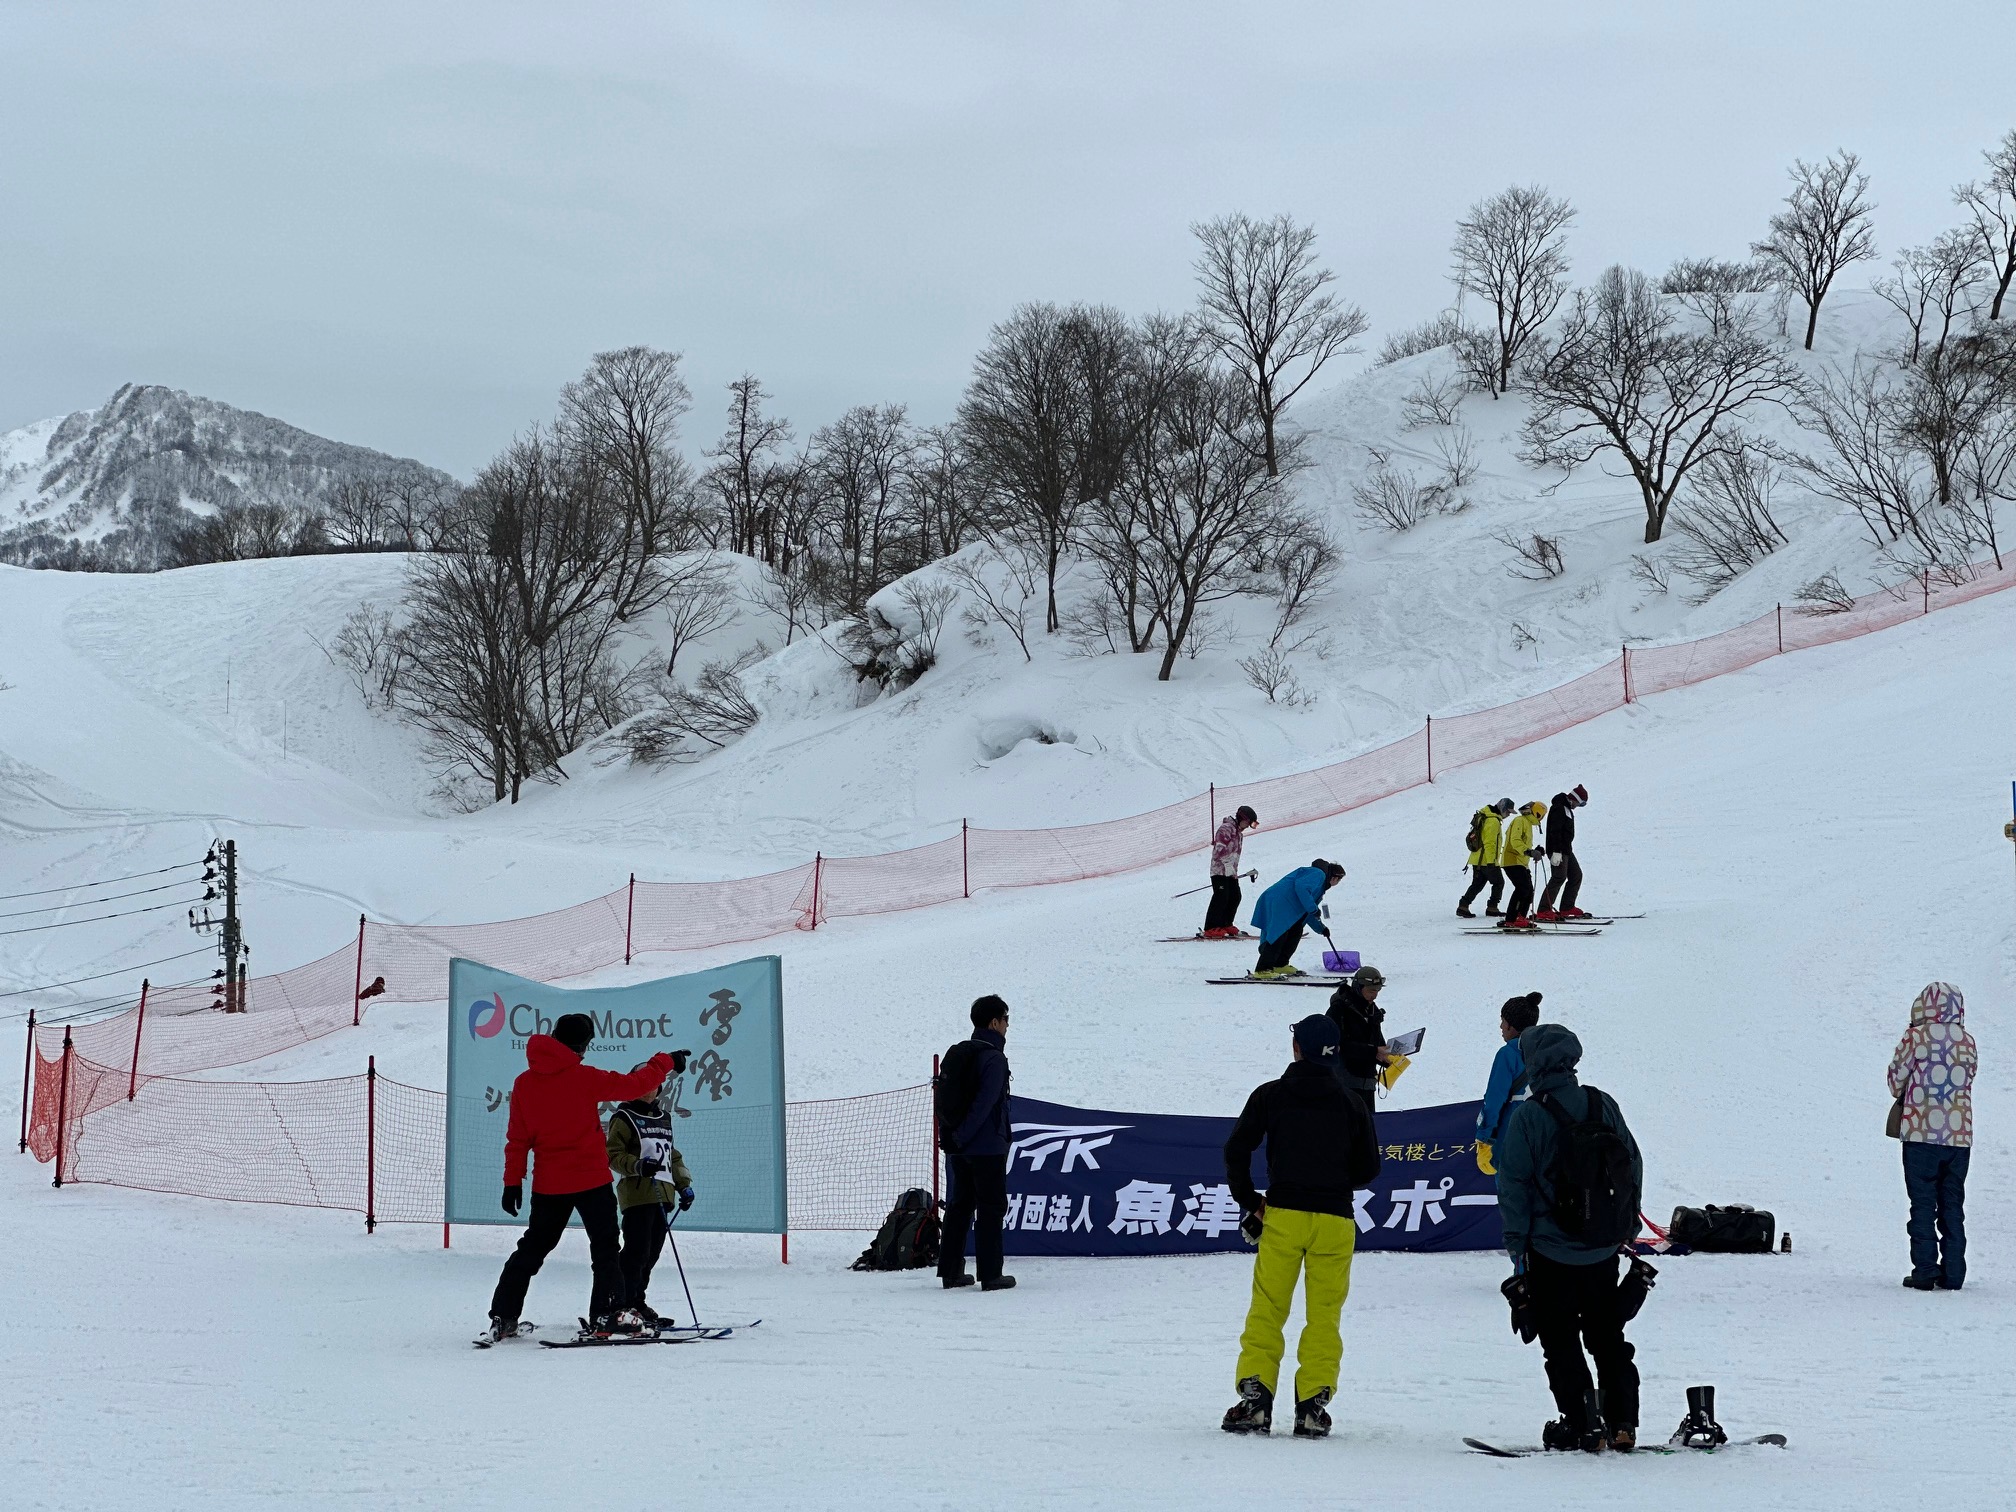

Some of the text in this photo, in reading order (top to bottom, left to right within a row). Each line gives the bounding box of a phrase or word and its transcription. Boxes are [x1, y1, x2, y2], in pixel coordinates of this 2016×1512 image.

[509, 1003, 673, 1039] ChMant
[587, 1043, 627, 1052] Resort
[1378, 1142, 1480, 1162] 気楼とス
